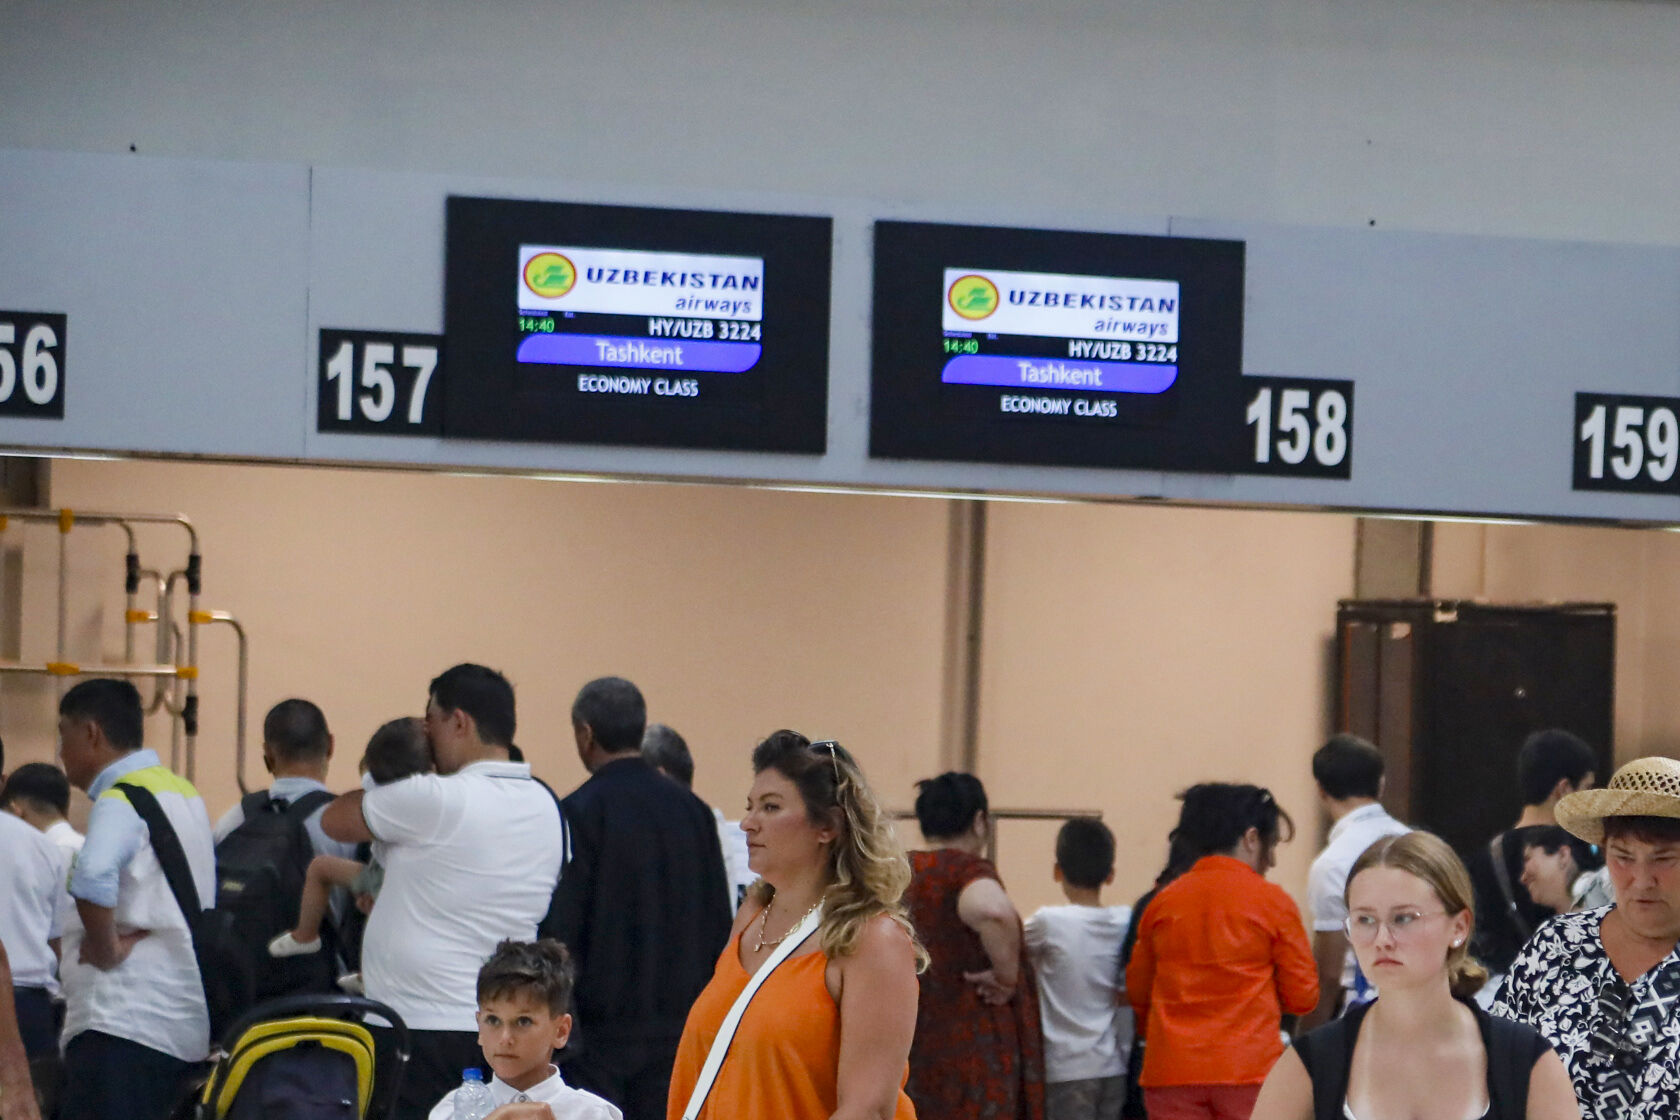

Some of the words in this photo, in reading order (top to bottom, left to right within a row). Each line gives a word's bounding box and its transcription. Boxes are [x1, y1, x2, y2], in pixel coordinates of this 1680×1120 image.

[586, 267, 760, 290] UZBEKISTAN
[675, 295, 752, 317] airways
[1008, 290, 1176, 314] UZBEKISTAN
[519, 317, 554, 333] 14:40
[649, 319, 713, 338] HY/UZB
[719, 322, 761, 341] 3224
[1094, 318, 1168, 338] airways
[596, 341, 683, 365] Tashkent
[943, 338, 978, 354] 14:40
[1069, 340, 1131, 360] HY/UZB
[1135, 343, 1177, 362] 3224
[327, 340, 438, 424] 157
[1018, 361, 1102, 386] Tashkent
[578, 374, 651, 394] ECONOMY
[654, 378, 699, 397] CLASS
[1001, 395, 1072, 416] ECONOMY
[1074, 399, 1118, 418] CLASS
[1246, 388, 1347, 467] 158
[1580, 404, 1679, 482] 159
